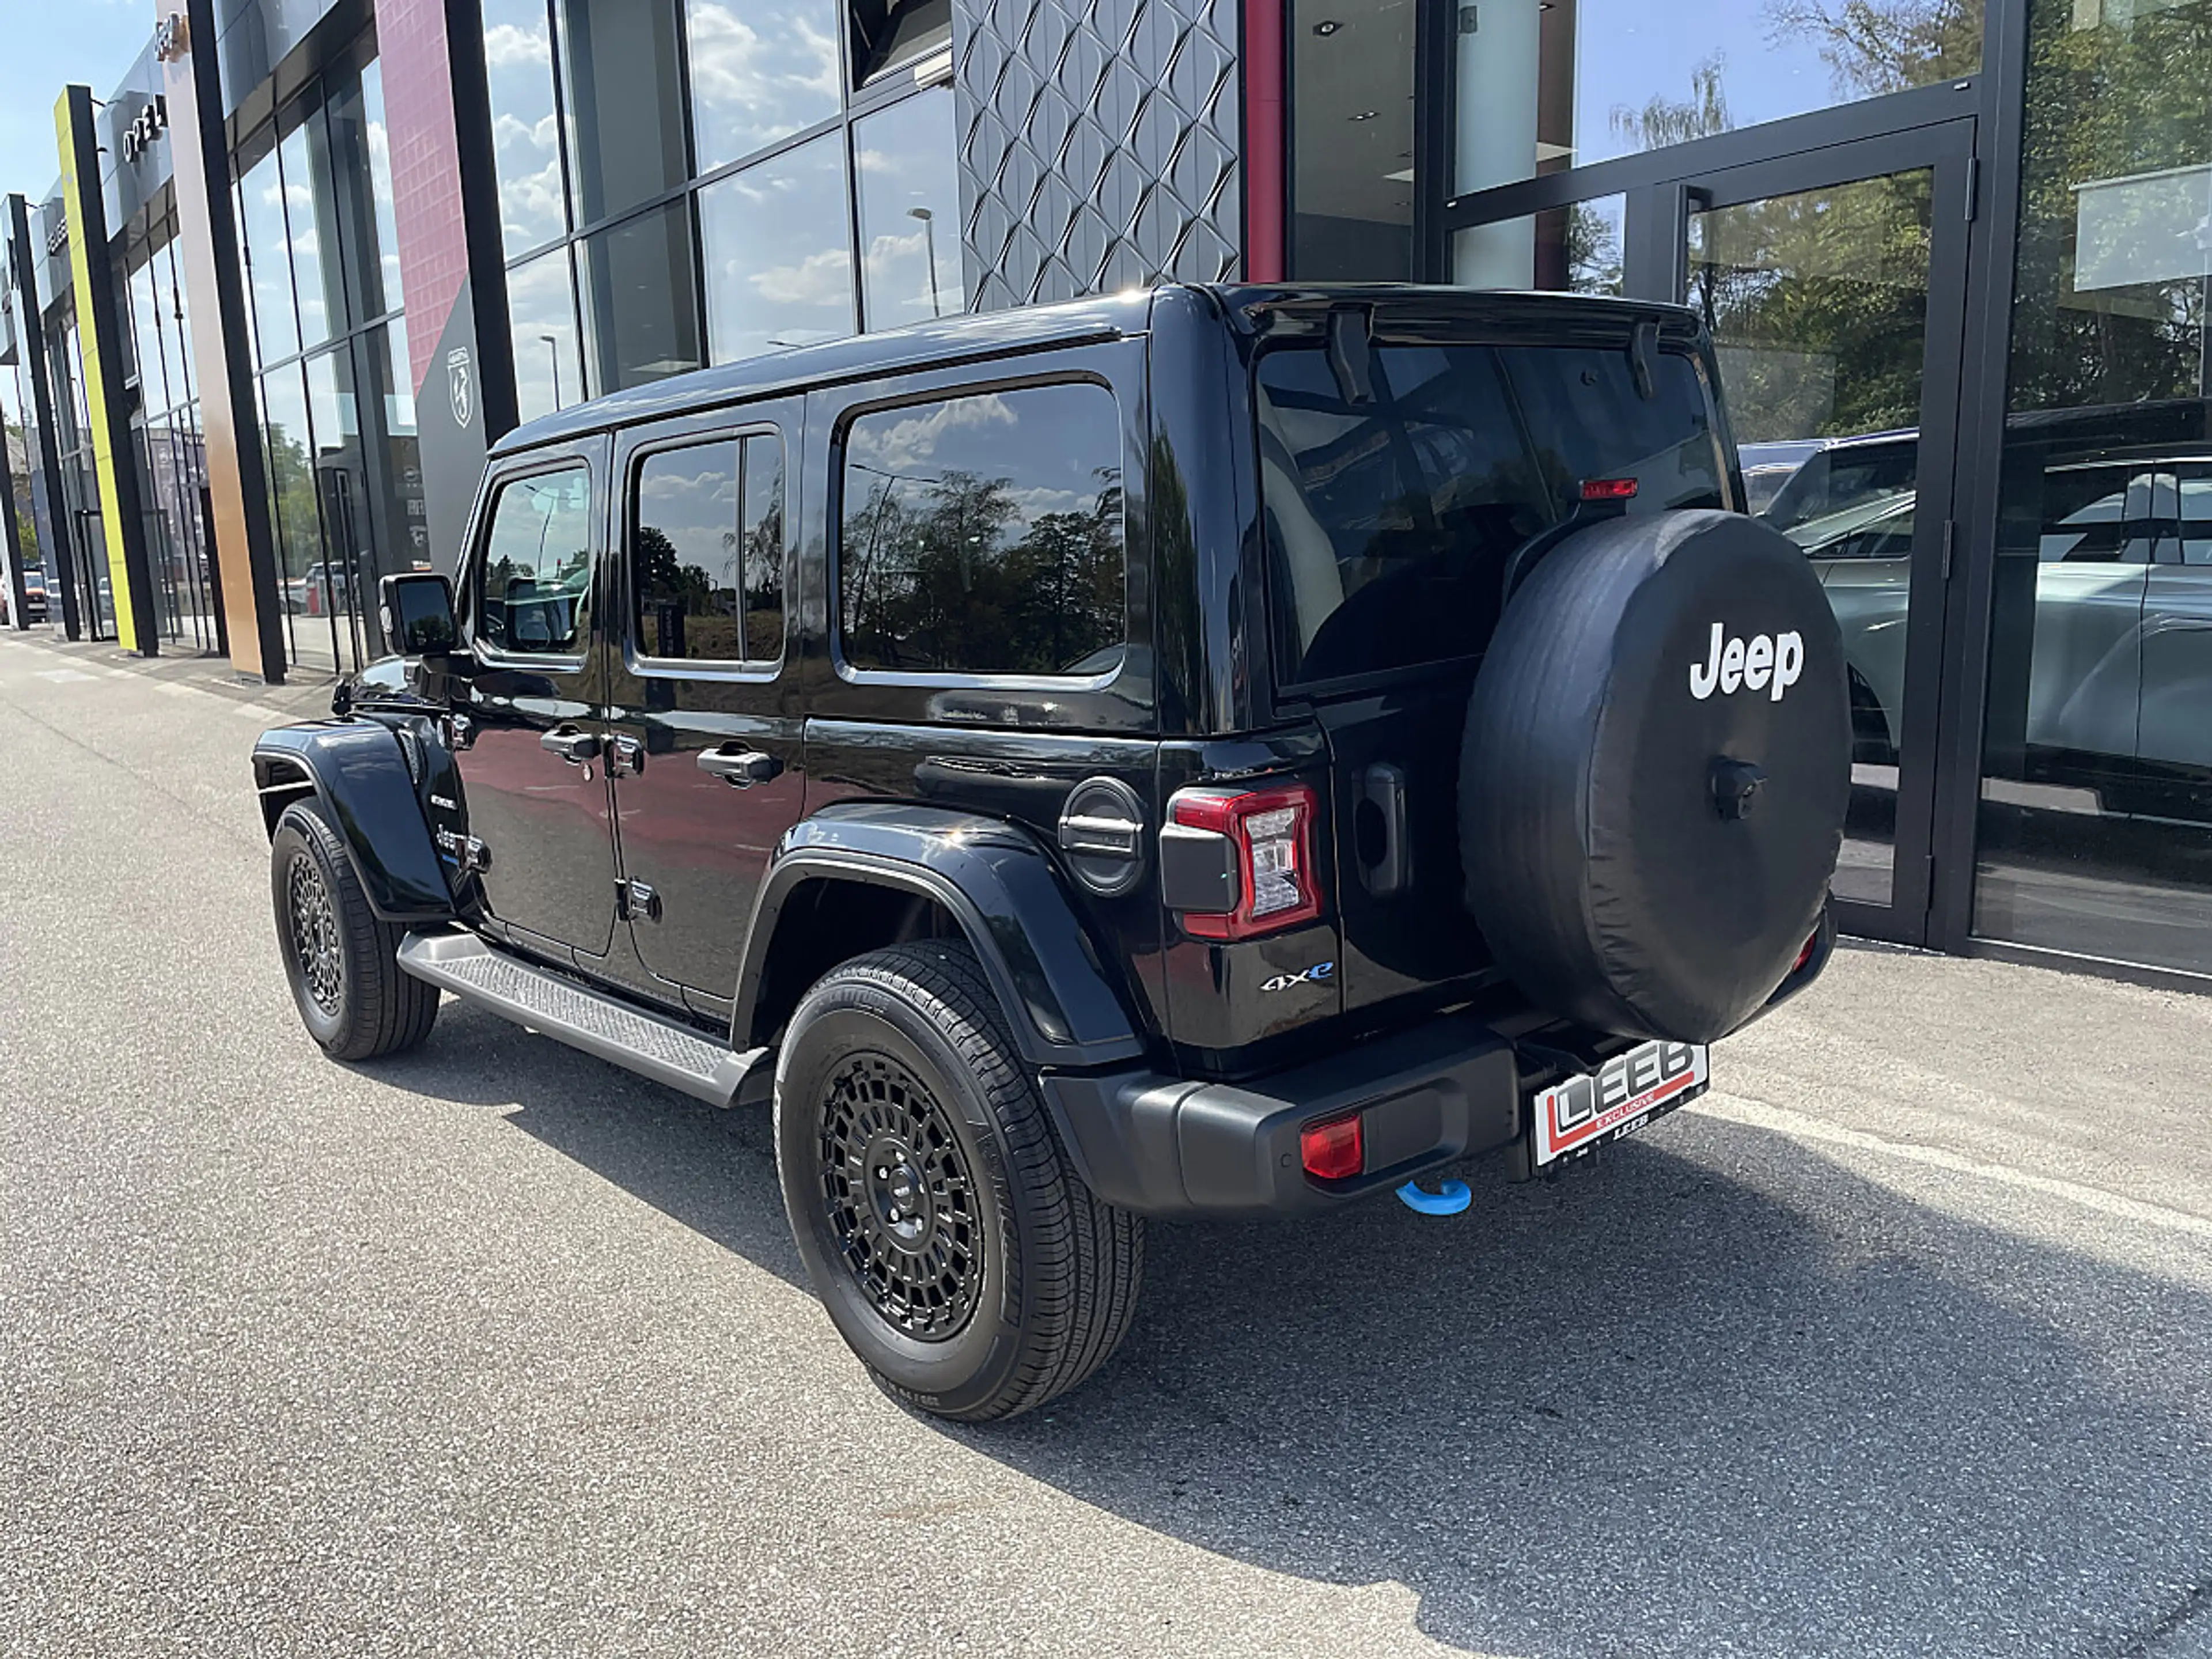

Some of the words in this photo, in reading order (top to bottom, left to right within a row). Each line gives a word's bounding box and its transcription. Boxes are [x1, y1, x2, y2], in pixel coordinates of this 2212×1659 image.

[123, 93, 168, 162] OPEL
[1690, 622, 1804, 701] Jeep
[1260, 961, 1334, 991] 4xe
[1558, 1040, 1695, 1132] LEEB
[1596, 1090, 1655, 1130] EXCLUSIVE
[1613, 1113, 1649, 1140] LEEB
